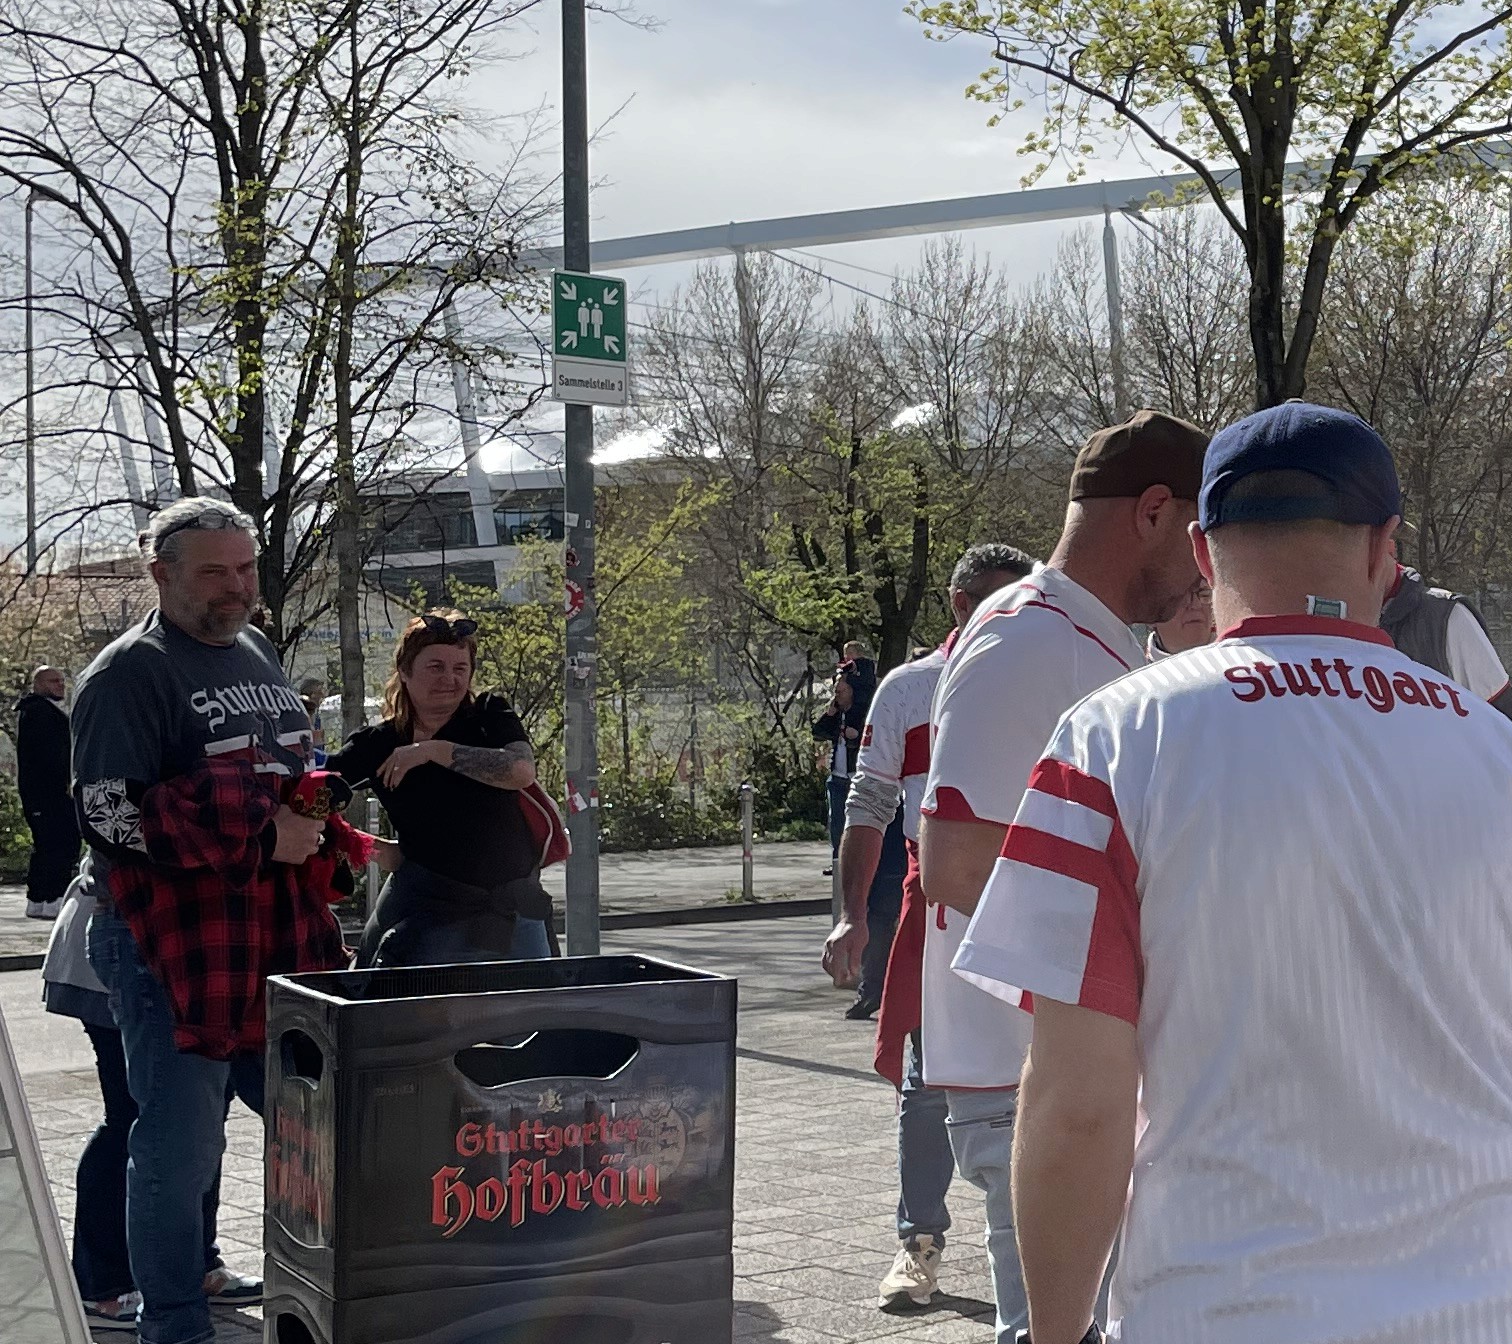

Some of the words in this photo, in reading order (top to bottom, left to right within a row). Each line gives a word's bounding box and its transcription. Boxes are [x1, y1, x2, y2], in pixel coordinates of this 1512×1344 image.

[559, 374, 615, 391] Sammelstelle
[618, 380, 623, 392] 3
[191, 680, 308, 734] Stuttgar
[1223, 658, 1470, 718] Stuttgart
[456, 1114, 642, 1157] Stuttgarter
[431, 1153, 662, 1238] Hofbräu
